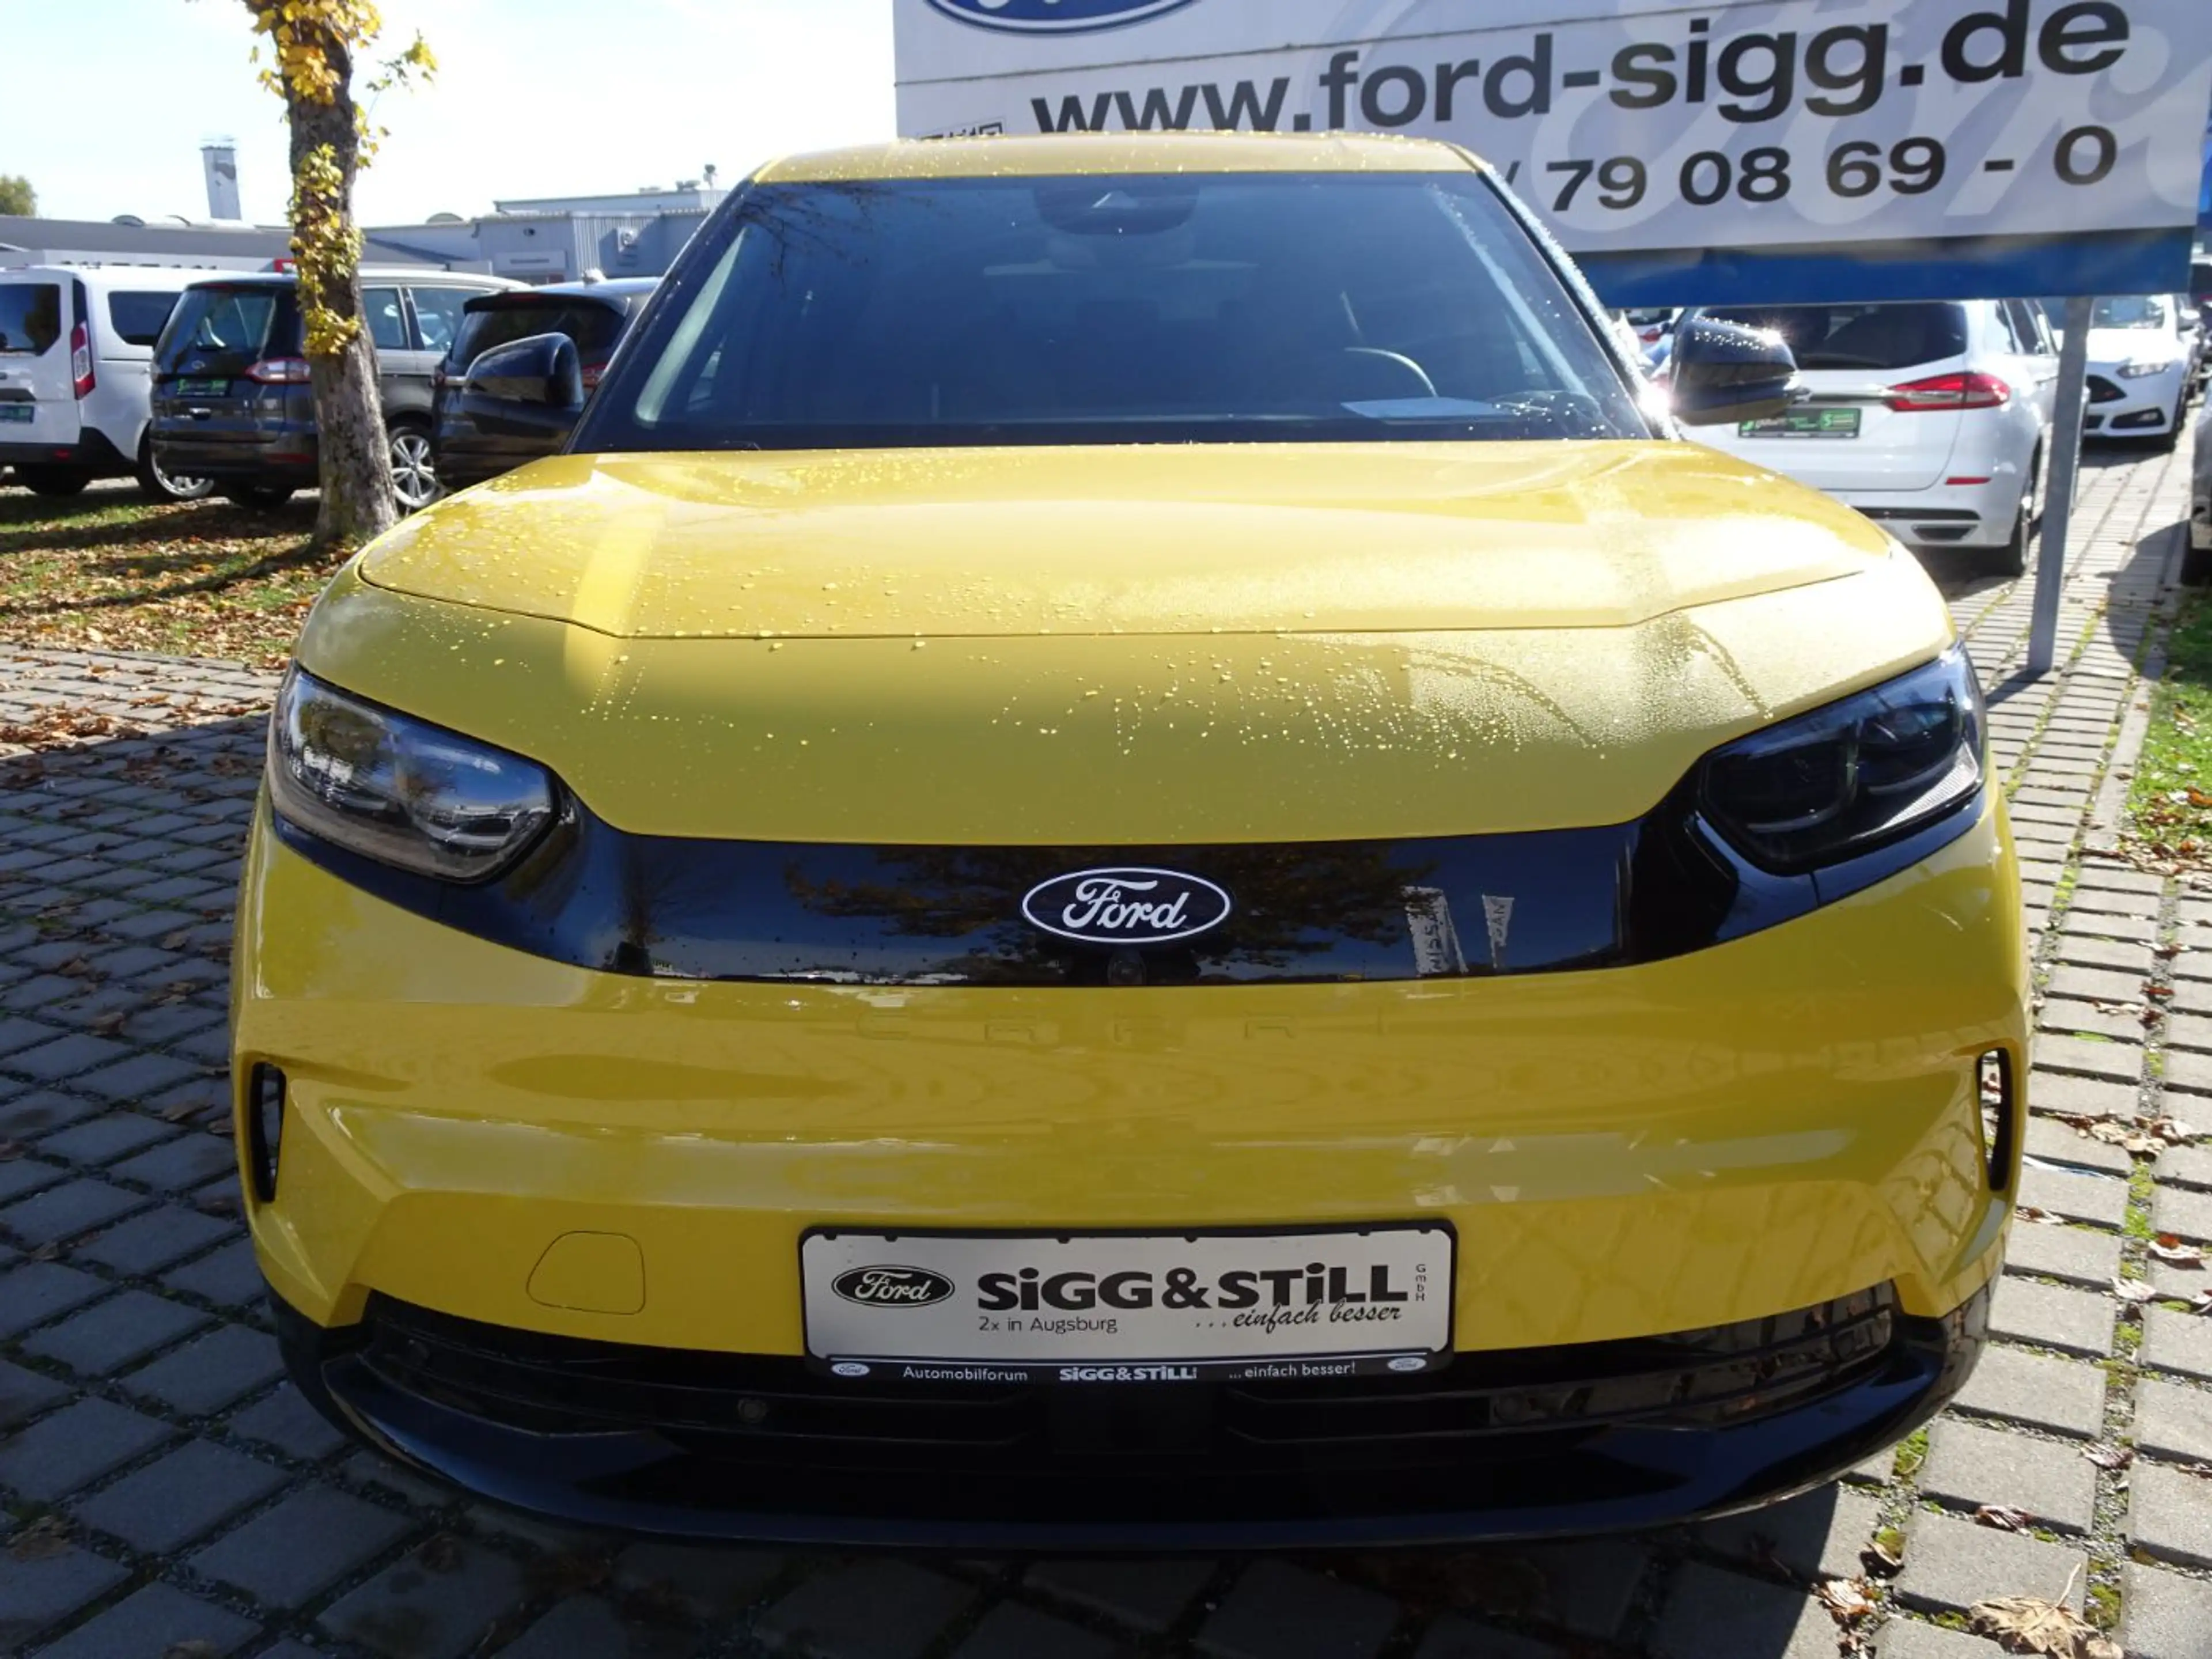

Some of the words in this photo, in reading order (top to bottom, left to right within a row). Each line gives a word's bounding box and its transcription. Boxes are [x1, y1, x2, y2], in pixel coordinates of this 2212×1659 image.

[1031, 0, 2130, 132] www.ford-sigg.de
[1546, 156, 1647, 211] 79
[1679, 146, 1791, 206] 08
[1825, 136, 1947, 198] 69
[2053, 125, 2118, 185] 0
[1062, 878, 1189, 930] Ford
[854, 1270, 933, 1301] Ford
[1415, 1264, 1426, 1301] GmbH
[979, 1316, 1000, 1331] 2x
[1007, 1317, 1022, 1331] in
[1030, 1316, 1118, 1335] Augsburg
[1329, 1298, 1402, 1323] besser
[903, 1365, 1028, 1381] Automobilforum
[1301, 1361, 1356, 1376] besser!
